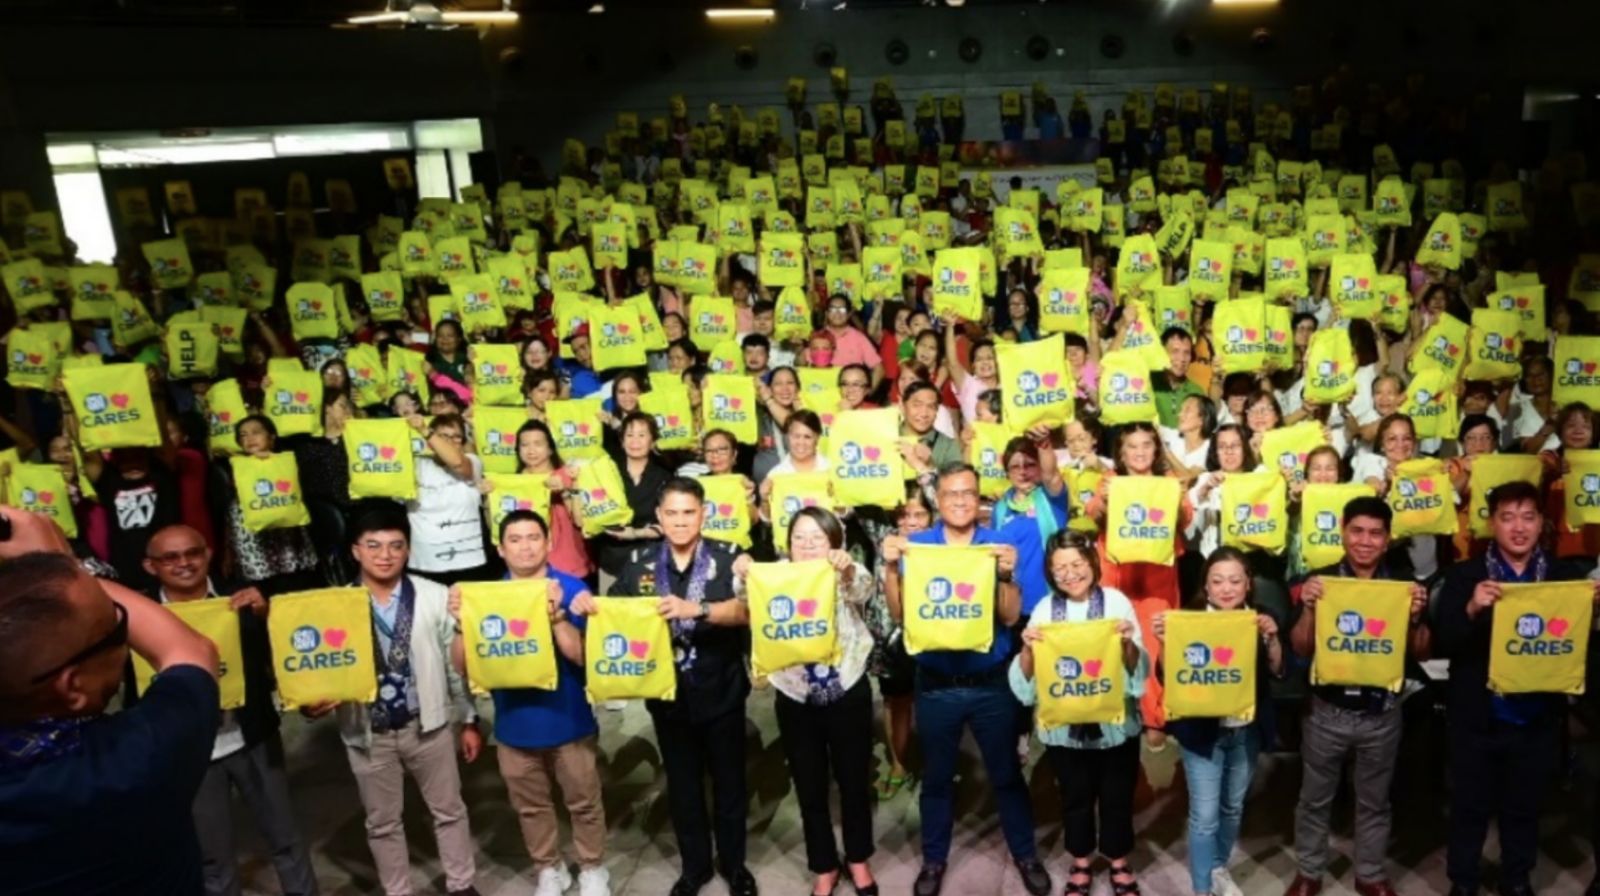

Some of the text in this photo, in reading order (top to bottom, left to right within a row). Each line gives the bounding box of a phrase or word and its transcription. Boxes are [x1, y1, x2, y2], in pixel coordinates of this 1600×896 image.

[180, 330, 196, 374] HELP
[1223, 342, 1263, 354] CARES
[1013, 388, 1067, 407] CARES
[1103, 392, 1149, 404] CARES
[271, 405, 315, 415] CARES
[709, 412, 747, 421] CARES
[81, 411, 140, 428] CARES
[556, 437, 597, 448] CARES
[482, 446, 515, 455] CARE
[352, 462, 403, 473] CARES
[836, 464, 889, 478] CARES
[251, 495, 297, 510] CARES
[1393, 494, 1442, 512] CARES
[701, 519, 739, 530] ARES
[1228, 520, 1276, 536] CARES
[1119, 526, 1169, 539] CARES
[1308, 532, 1342, 546] CAR
[919, 604, 983, 619] CARES
[762, 620, 828, 640] CARES
[476, 639, 538, 658] CARES
[1327, 636, 1393, 654] CARES
[1506, 639, 1573, 655] CARES
[284, 649, 356, 672] CARES
[595, 660, 656, 676] CARES
[1177, 669, 1241, 684] CARES
[1050, 679, 1111, 697] CARES
